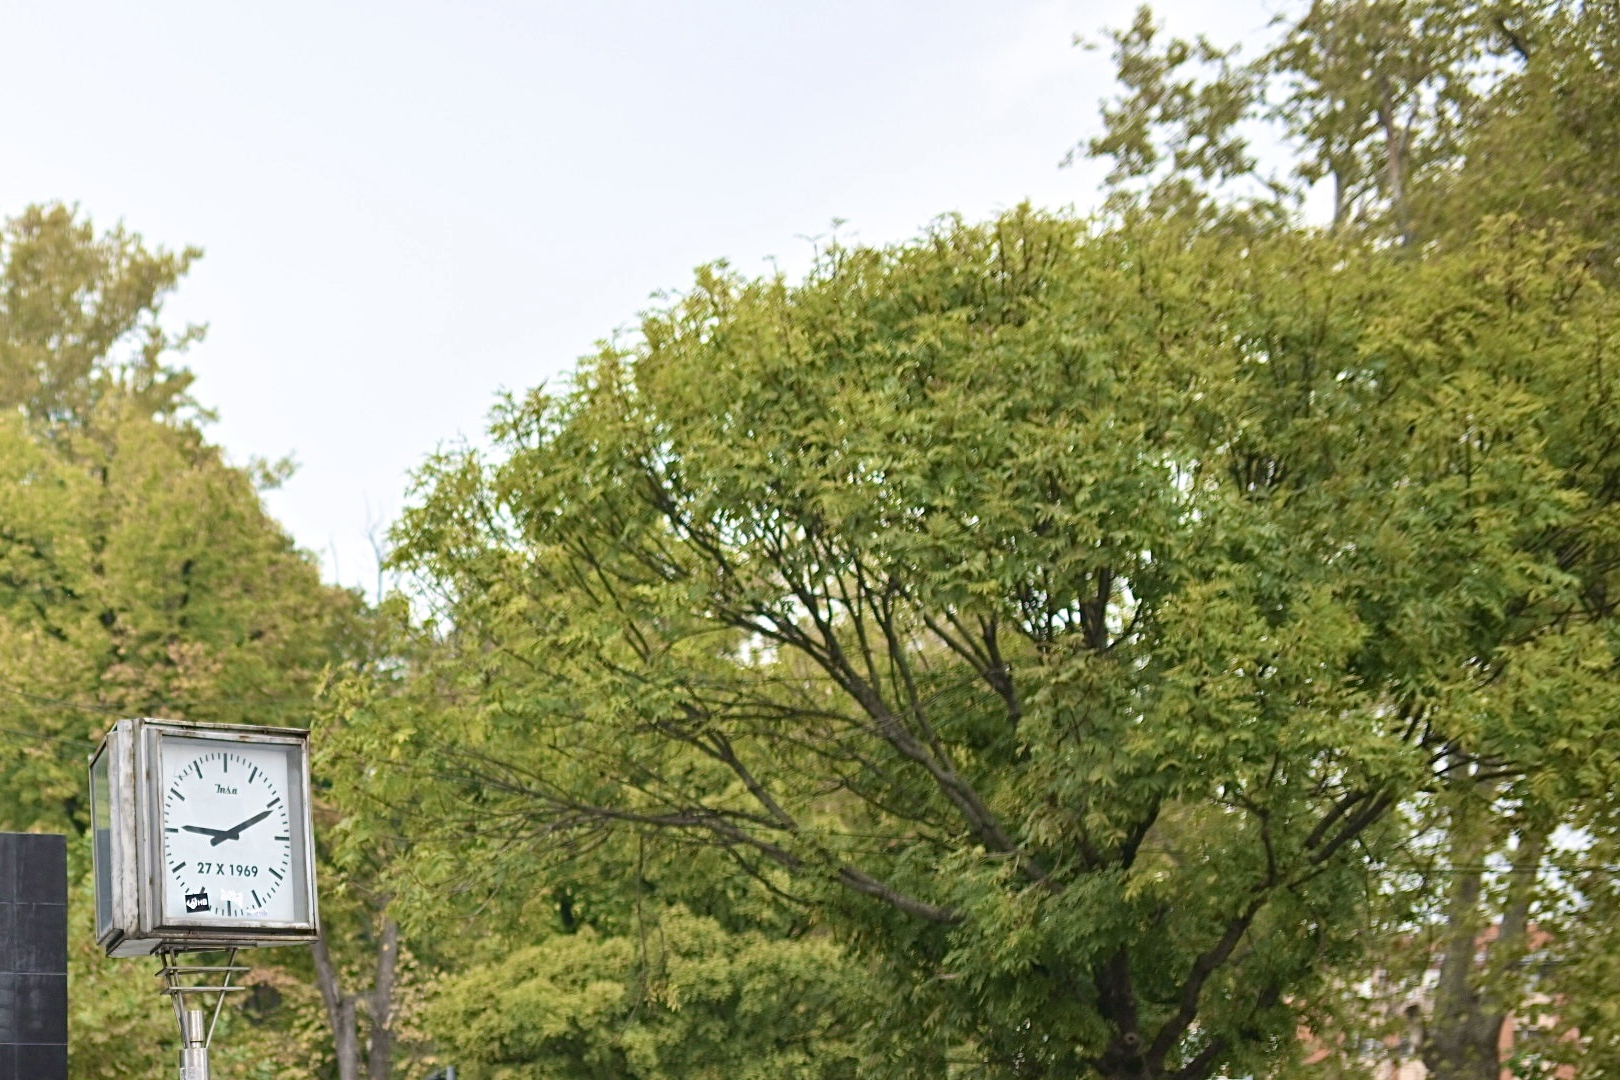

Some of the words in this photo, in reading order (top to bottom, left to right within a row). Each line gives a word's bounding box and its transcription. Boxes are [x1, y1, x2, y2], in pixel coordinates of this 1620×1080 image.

[197, 862, 212, 875] 27
[216, 863, 225, 876] X
[229, 864, 259, 877] 1969
